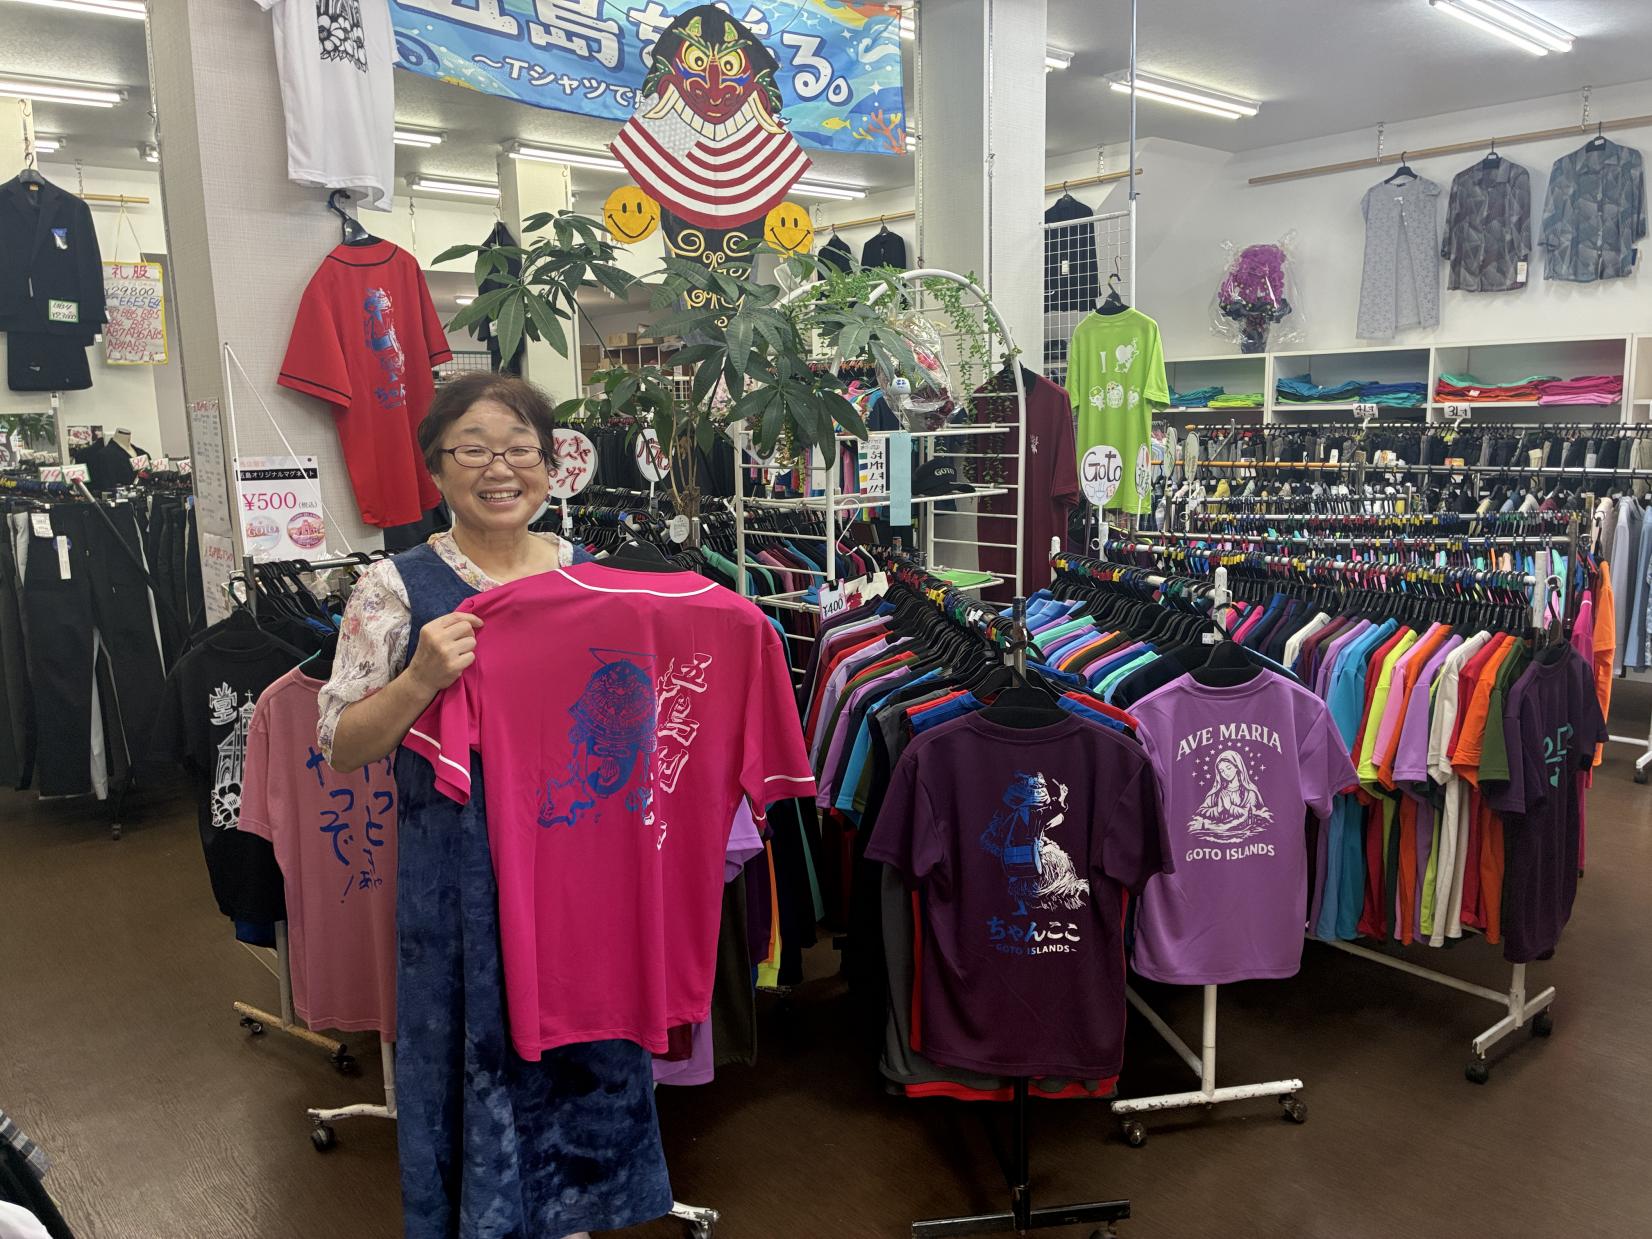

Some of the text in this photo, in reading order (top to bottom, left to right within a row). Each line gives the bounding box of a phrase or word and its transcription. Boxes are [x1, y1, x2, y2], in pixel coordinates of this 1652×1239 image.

[1082, 451, 1122, 482] Goto
[242, 491, 297, 511] ¥500
[822, 598, 844, 617] ¥400
[208, 681, 238, 726] 堂
[1176, 722, 1283, 762] AVE MARIA
[1185, 843, 1276, 862] GOTO ISLANDS
[986, 915, 1081, 943] ちゃんここ
